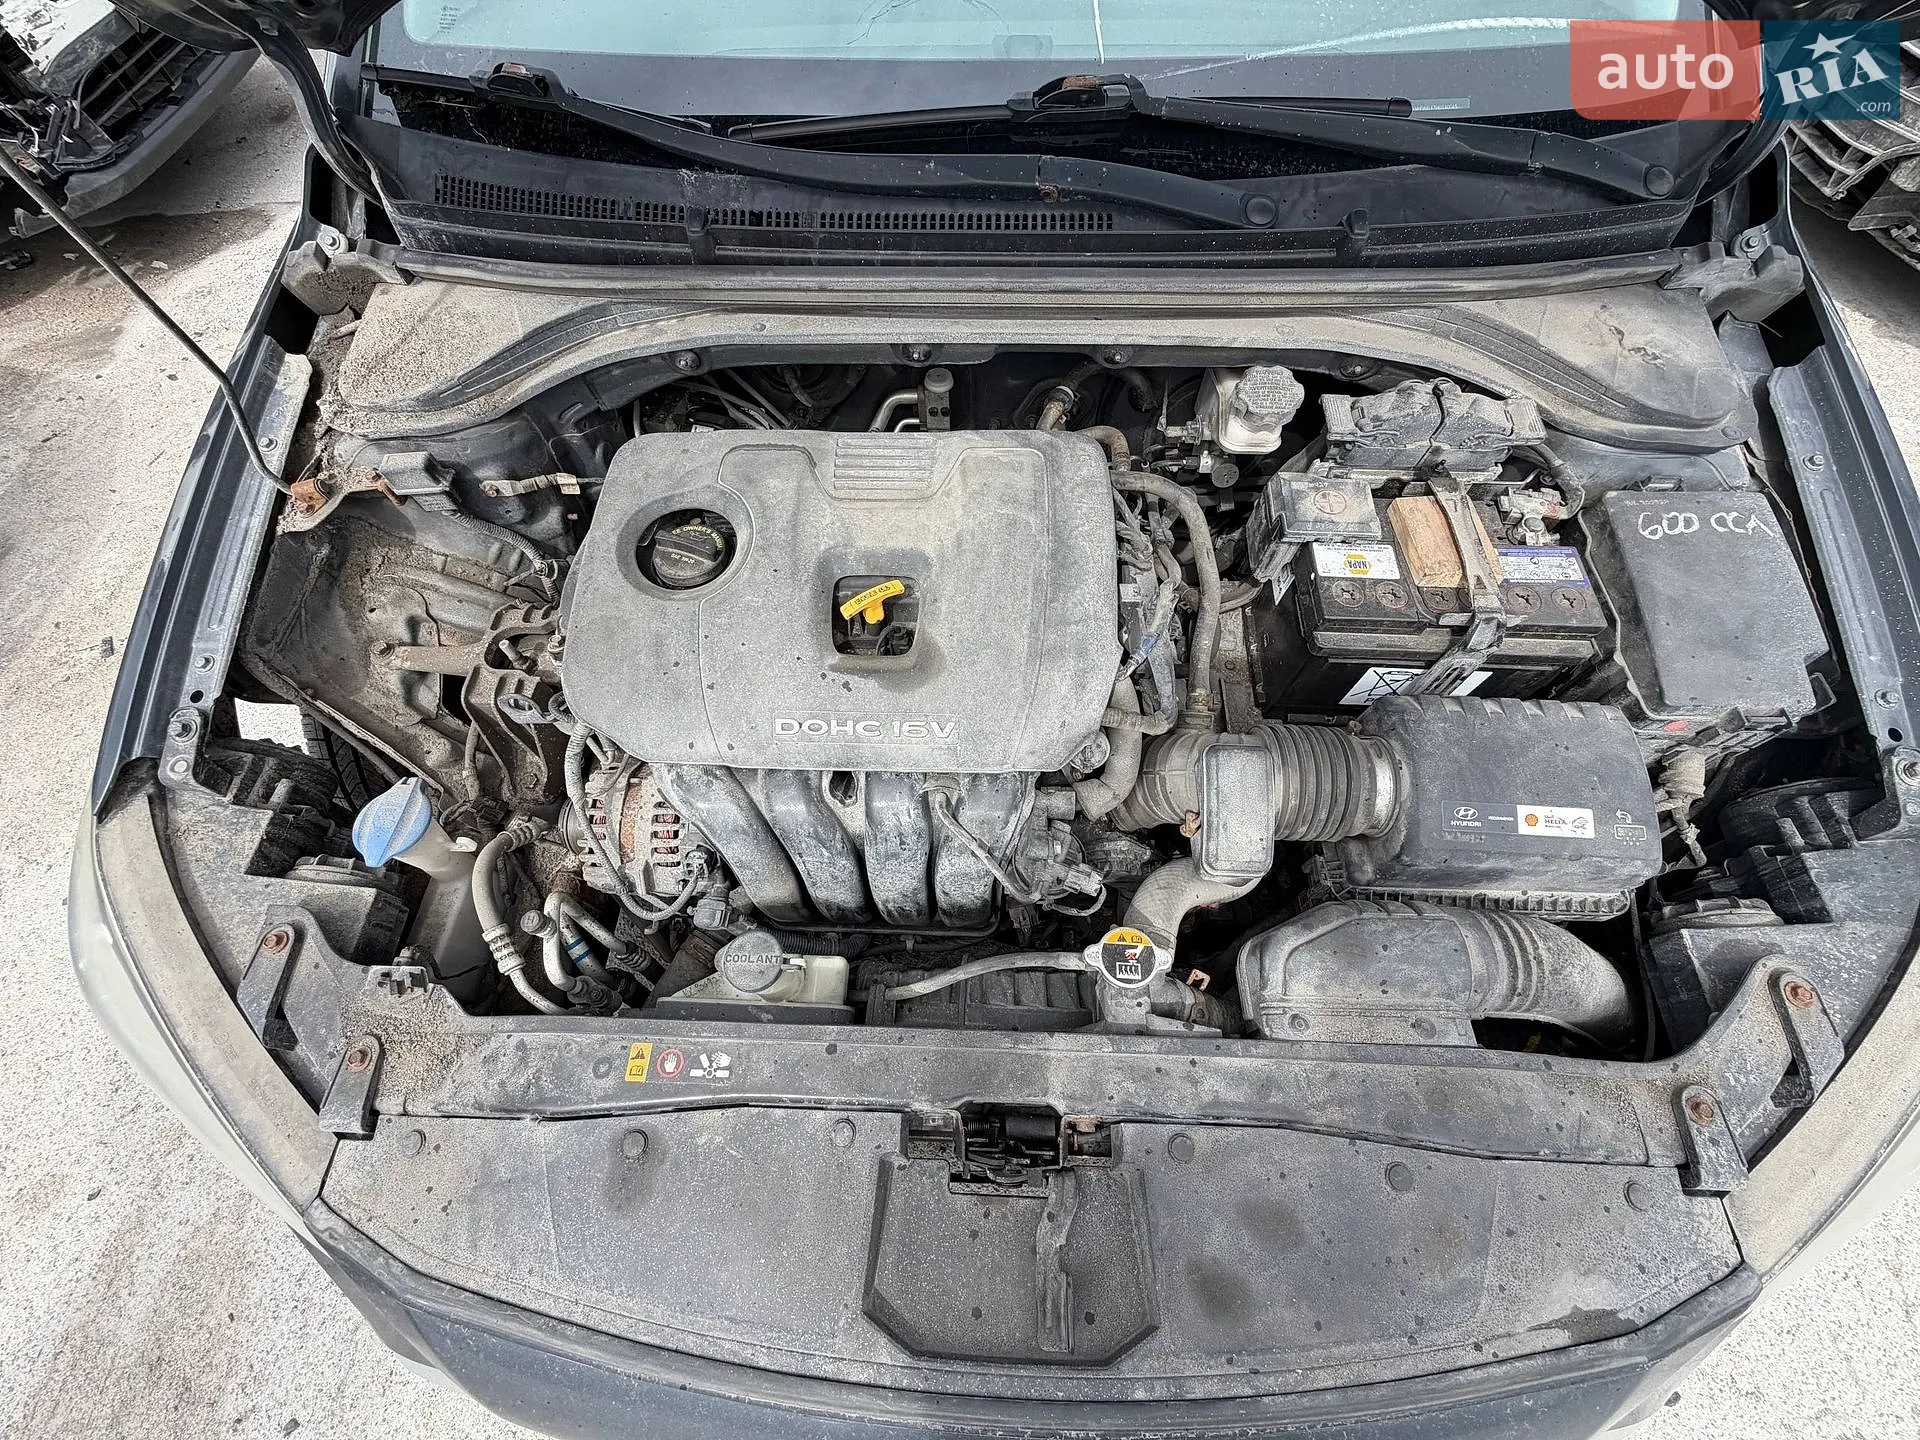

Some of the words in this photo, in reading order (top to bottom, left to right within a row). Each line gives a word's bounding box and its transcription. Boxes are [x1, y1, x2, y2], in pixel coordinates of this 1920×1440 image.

[1638, 512, 1699, 540] 600
[1710, 512, 1774, 537] CCA
[1347, 559, 1368, 569] NAPA
[775, 718, 882, 737] DOHC
[893, 720, 956, 738] 16V
[1450, 820, 1482, 828] HYUNDAI
[725, 953, 781, 964] COOLANT
